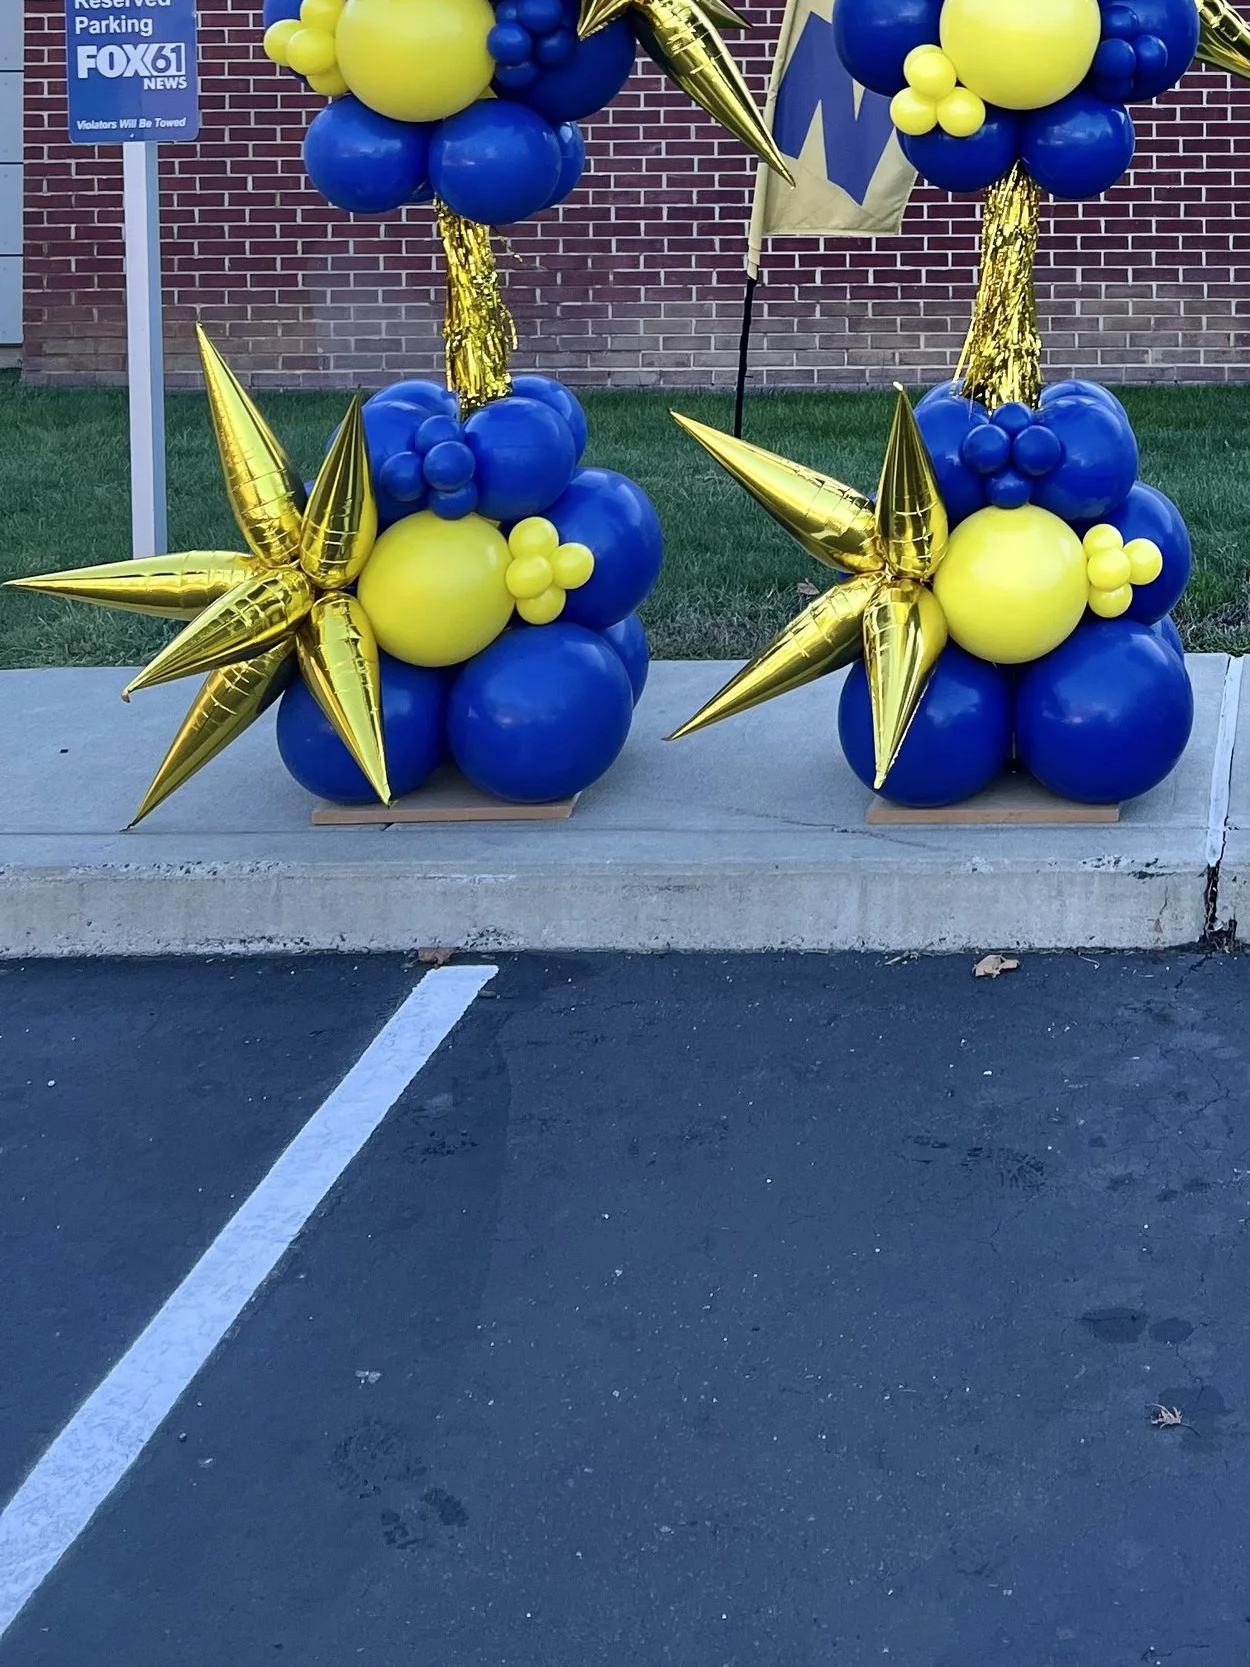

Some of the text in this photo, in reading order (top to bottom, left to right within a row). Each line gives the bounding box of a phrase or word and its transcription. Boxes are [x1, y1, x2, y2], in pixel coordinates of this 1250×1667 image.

[75, 16, 153, 36] Parking
[143, 77, 187, 90] NEWS
[77, 117, 187, 130] Violators Will Be Towed
